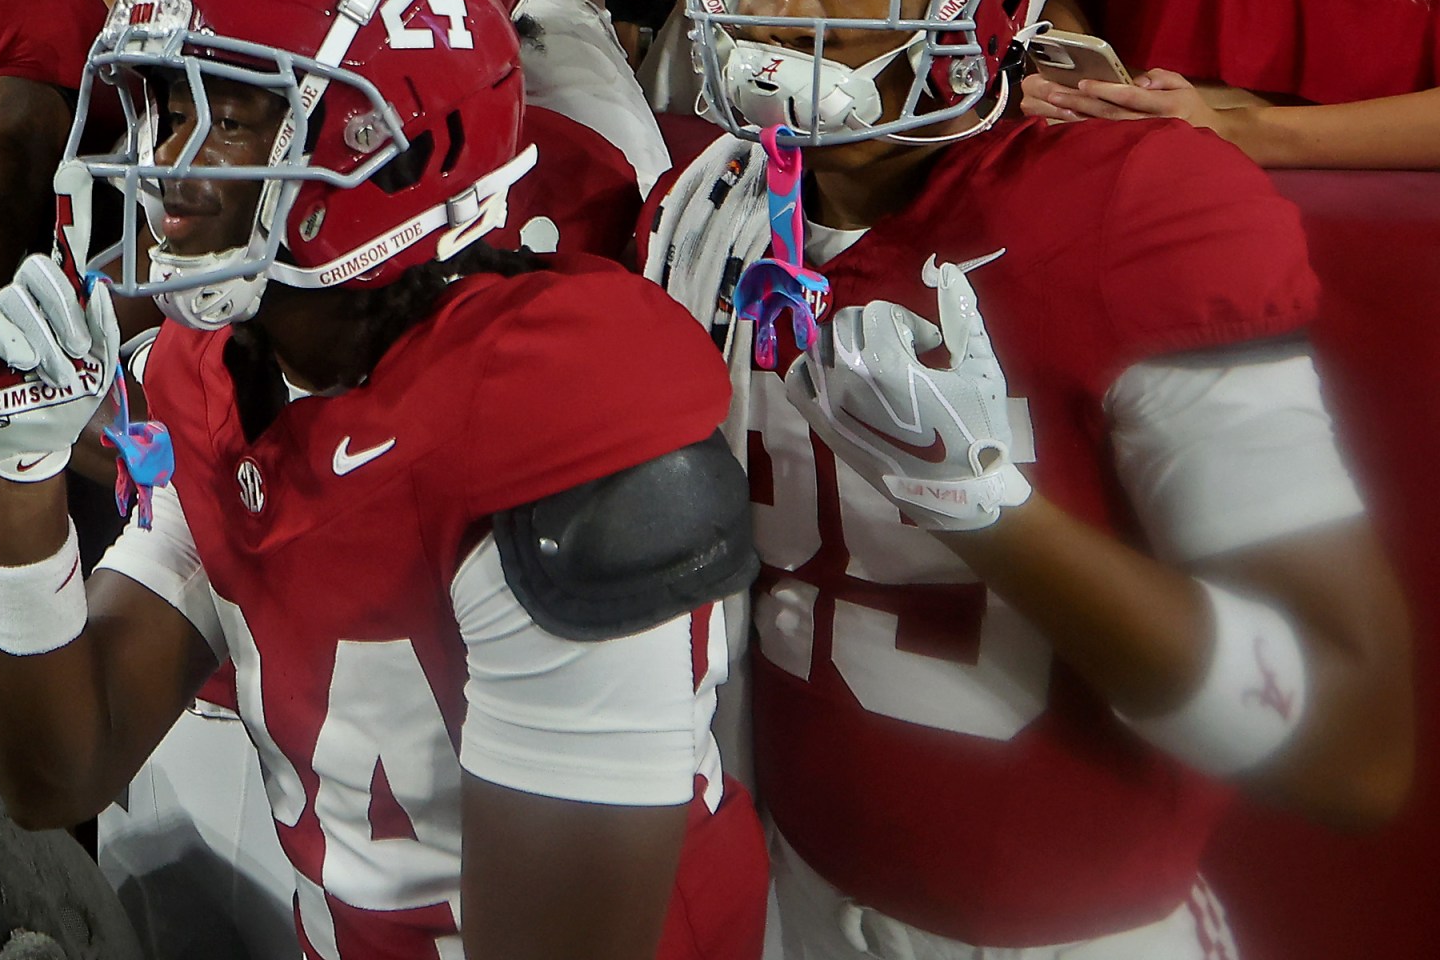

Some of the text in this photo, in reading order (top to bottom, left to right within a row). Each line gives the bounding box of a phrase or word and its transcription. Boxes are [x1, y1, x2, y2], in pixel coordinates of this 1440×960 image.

[318, 222, 424, 286] CRIMSON TIDE
[237, 461, 265, 514] SEC
